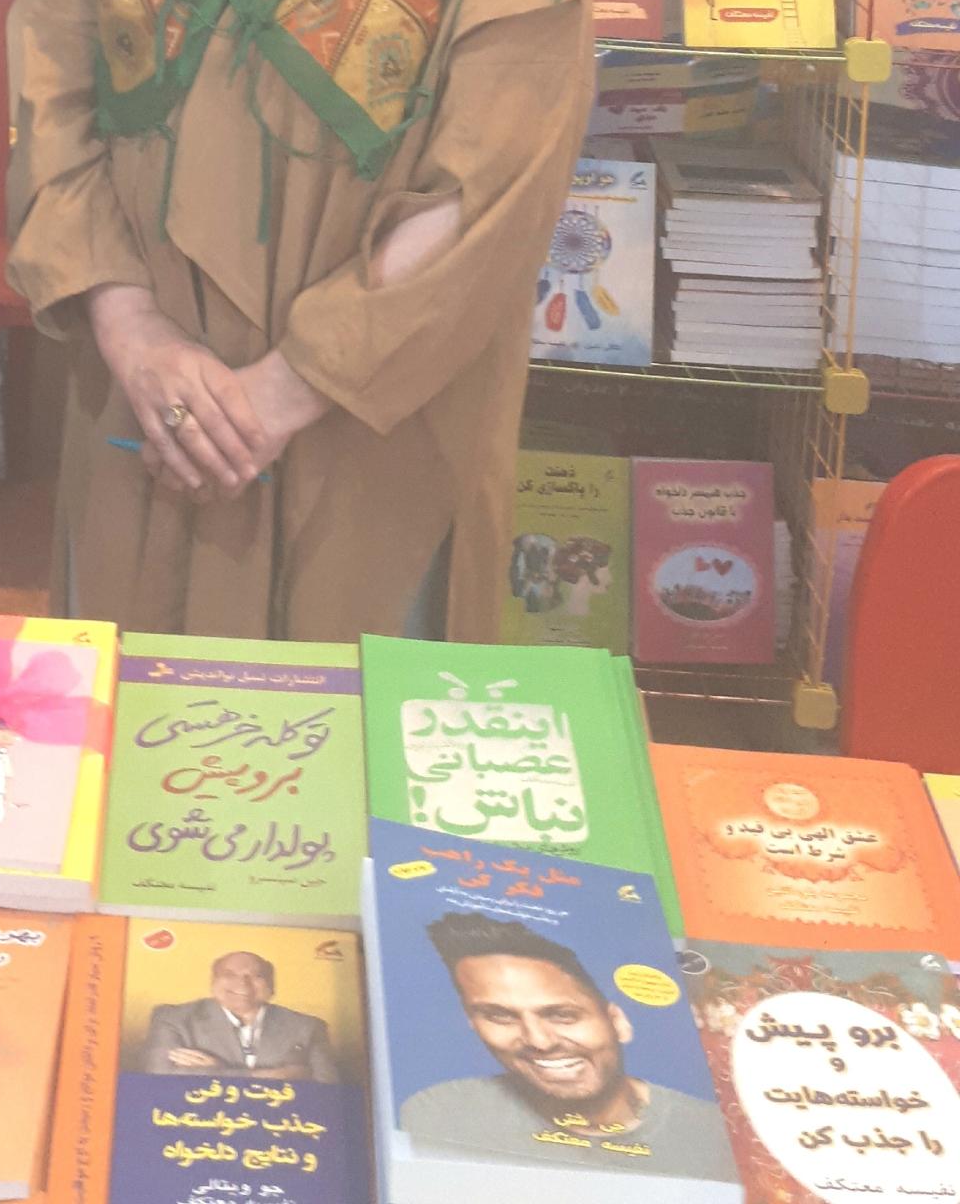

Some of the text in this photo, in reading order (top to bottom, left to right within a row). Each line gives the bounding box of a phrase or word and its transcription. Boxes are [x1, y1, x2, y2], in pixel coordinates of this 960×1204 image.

[409, 704, 568, 750] اینقدر
[407, 742, 573, 784] عصبانی
[726, 820, 879, 846] عشق الهی بی قید و
[765, 843, 846, 863] شرط است
[744, 1011, 901, 1052] برو پیش
[829, 1056, 846, 1072] و
[184, 1078, 297, 1108] فوت و فن
[260, 1112, 329, 1140] جذب
[797, 1125, 945, 1156] را جذب کن
[161, 1140, 319, 1173] و نتایج دلخواه
[813, 1177, 957, 1200] نفیسه معتکف
